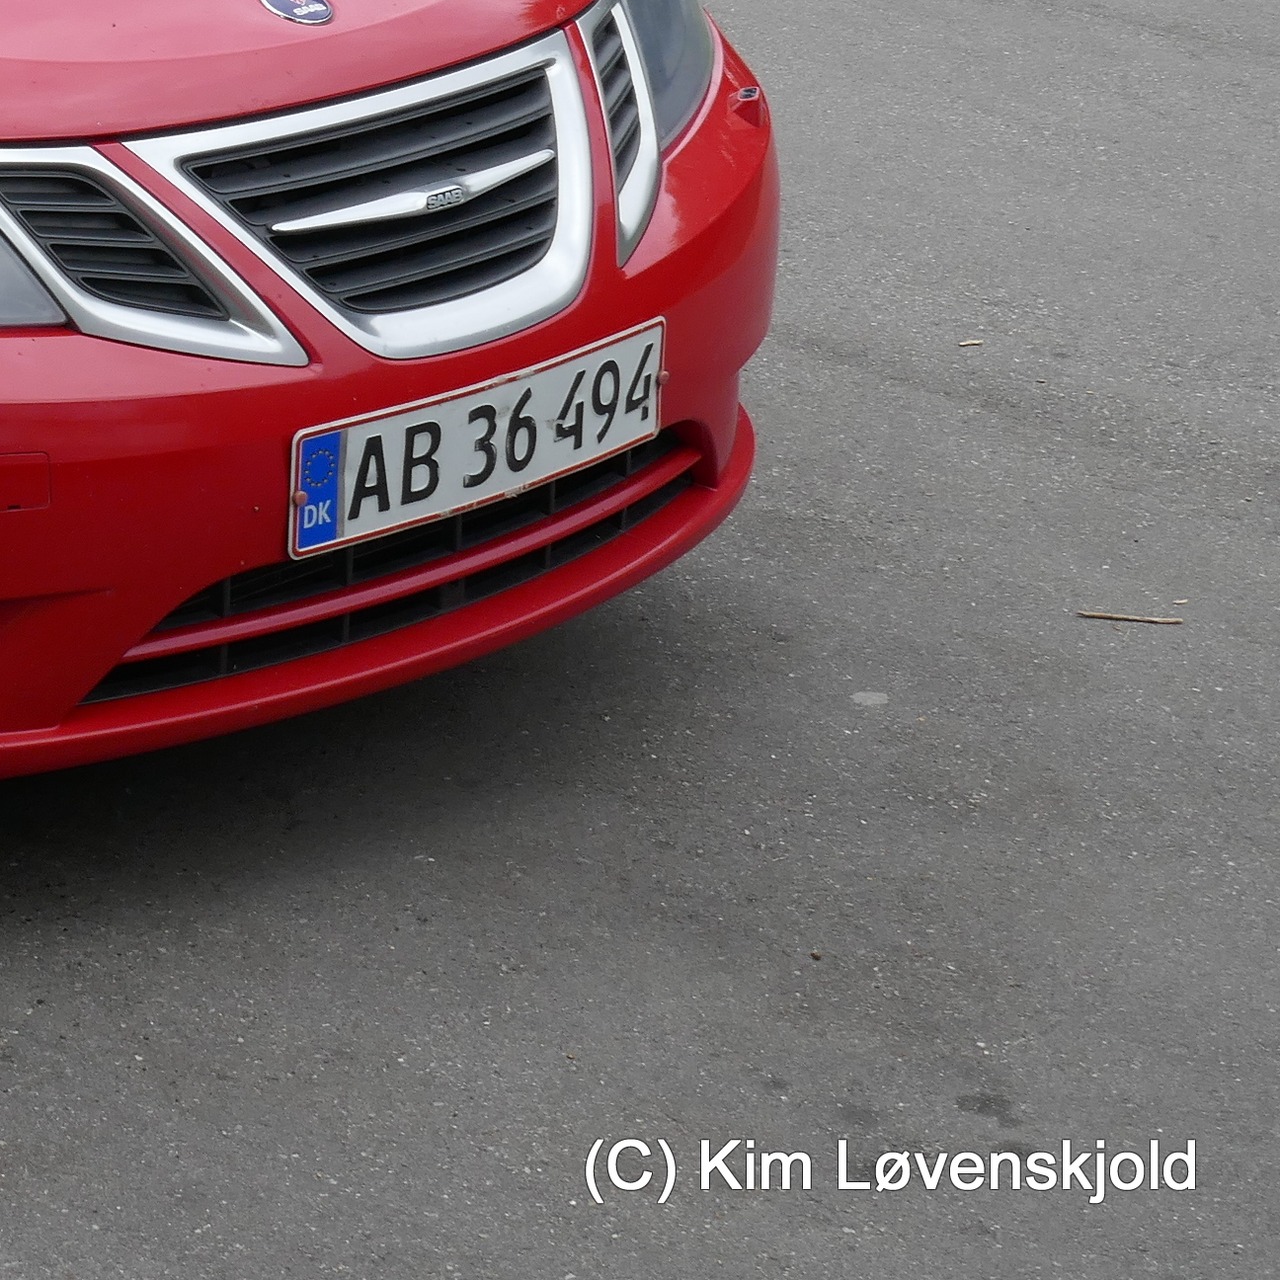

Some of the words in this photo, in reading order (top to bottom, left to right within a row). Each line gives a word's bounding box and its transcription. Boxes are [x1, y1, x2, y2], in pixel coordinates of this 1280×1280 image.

[427, 188, 463, 209] SAAB
[347, 421, 441, 521] AB
[462, 387, 537, 489] 36
[553, 342, 654, 451] 494
[303, 500, 332, 529] DK
